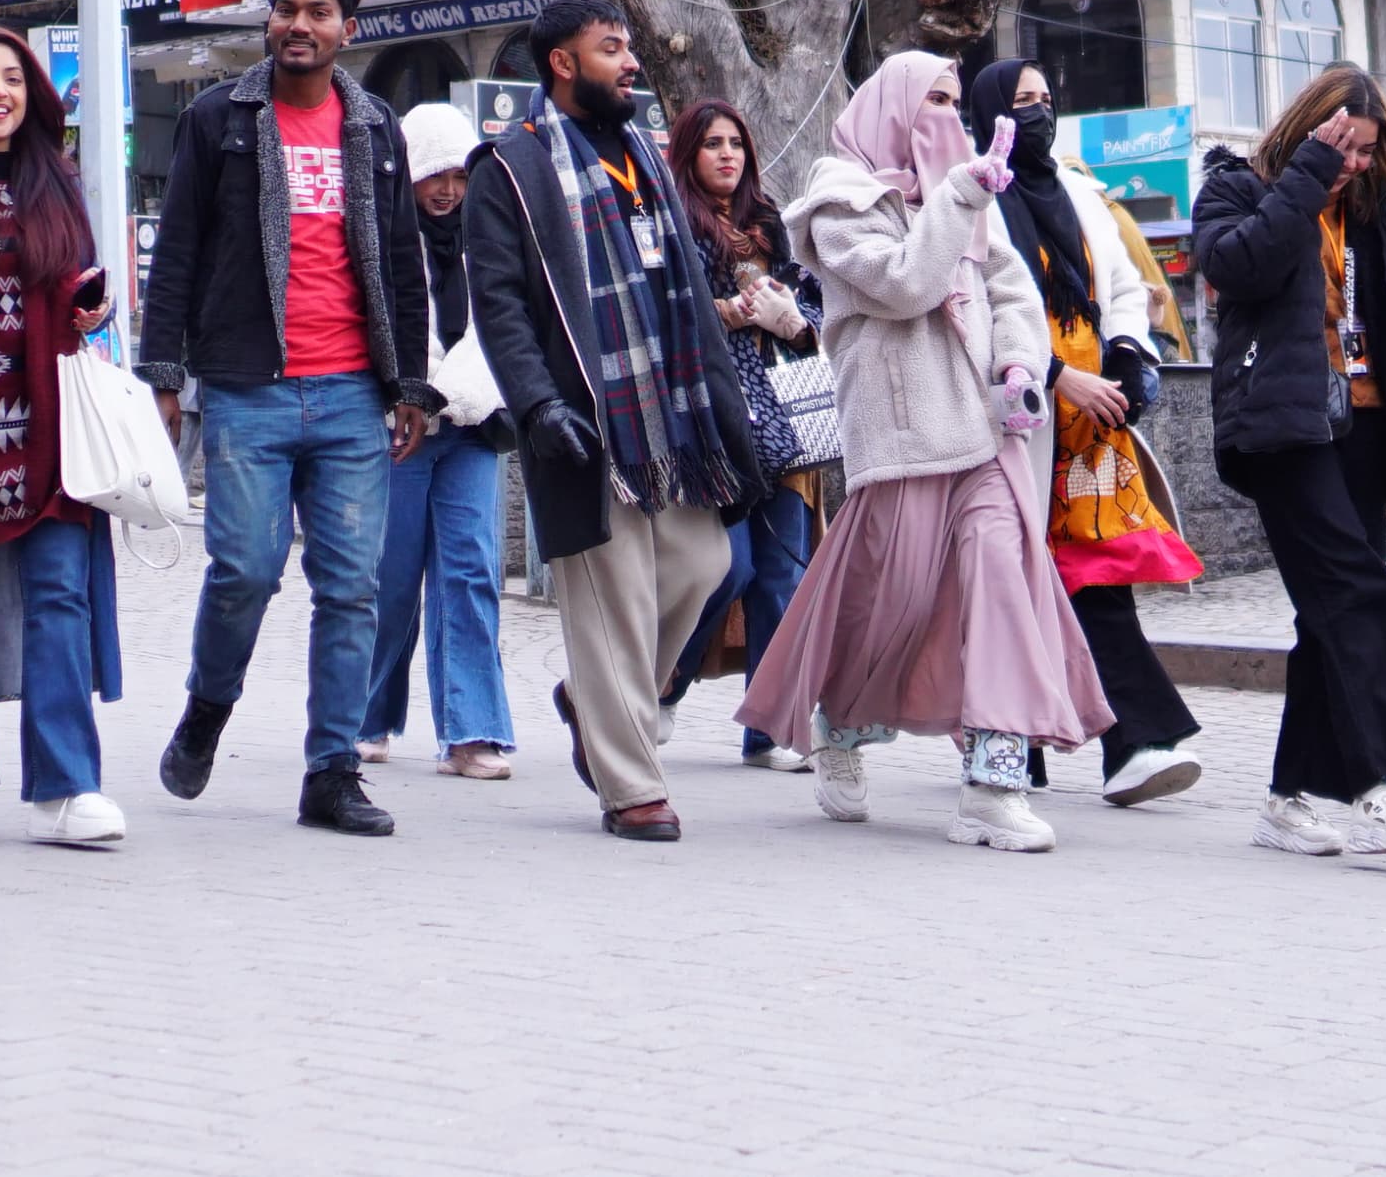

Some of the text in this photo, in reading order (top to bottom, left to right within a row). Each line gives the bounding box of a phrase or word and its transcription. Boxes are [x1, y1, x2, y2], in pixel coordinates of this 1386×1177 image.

[411, 4, 465, 30] ONION
[1103, 135, 1173, 154] PAINT FIX
[791, 395, 831, 413] CHRISTIAN
